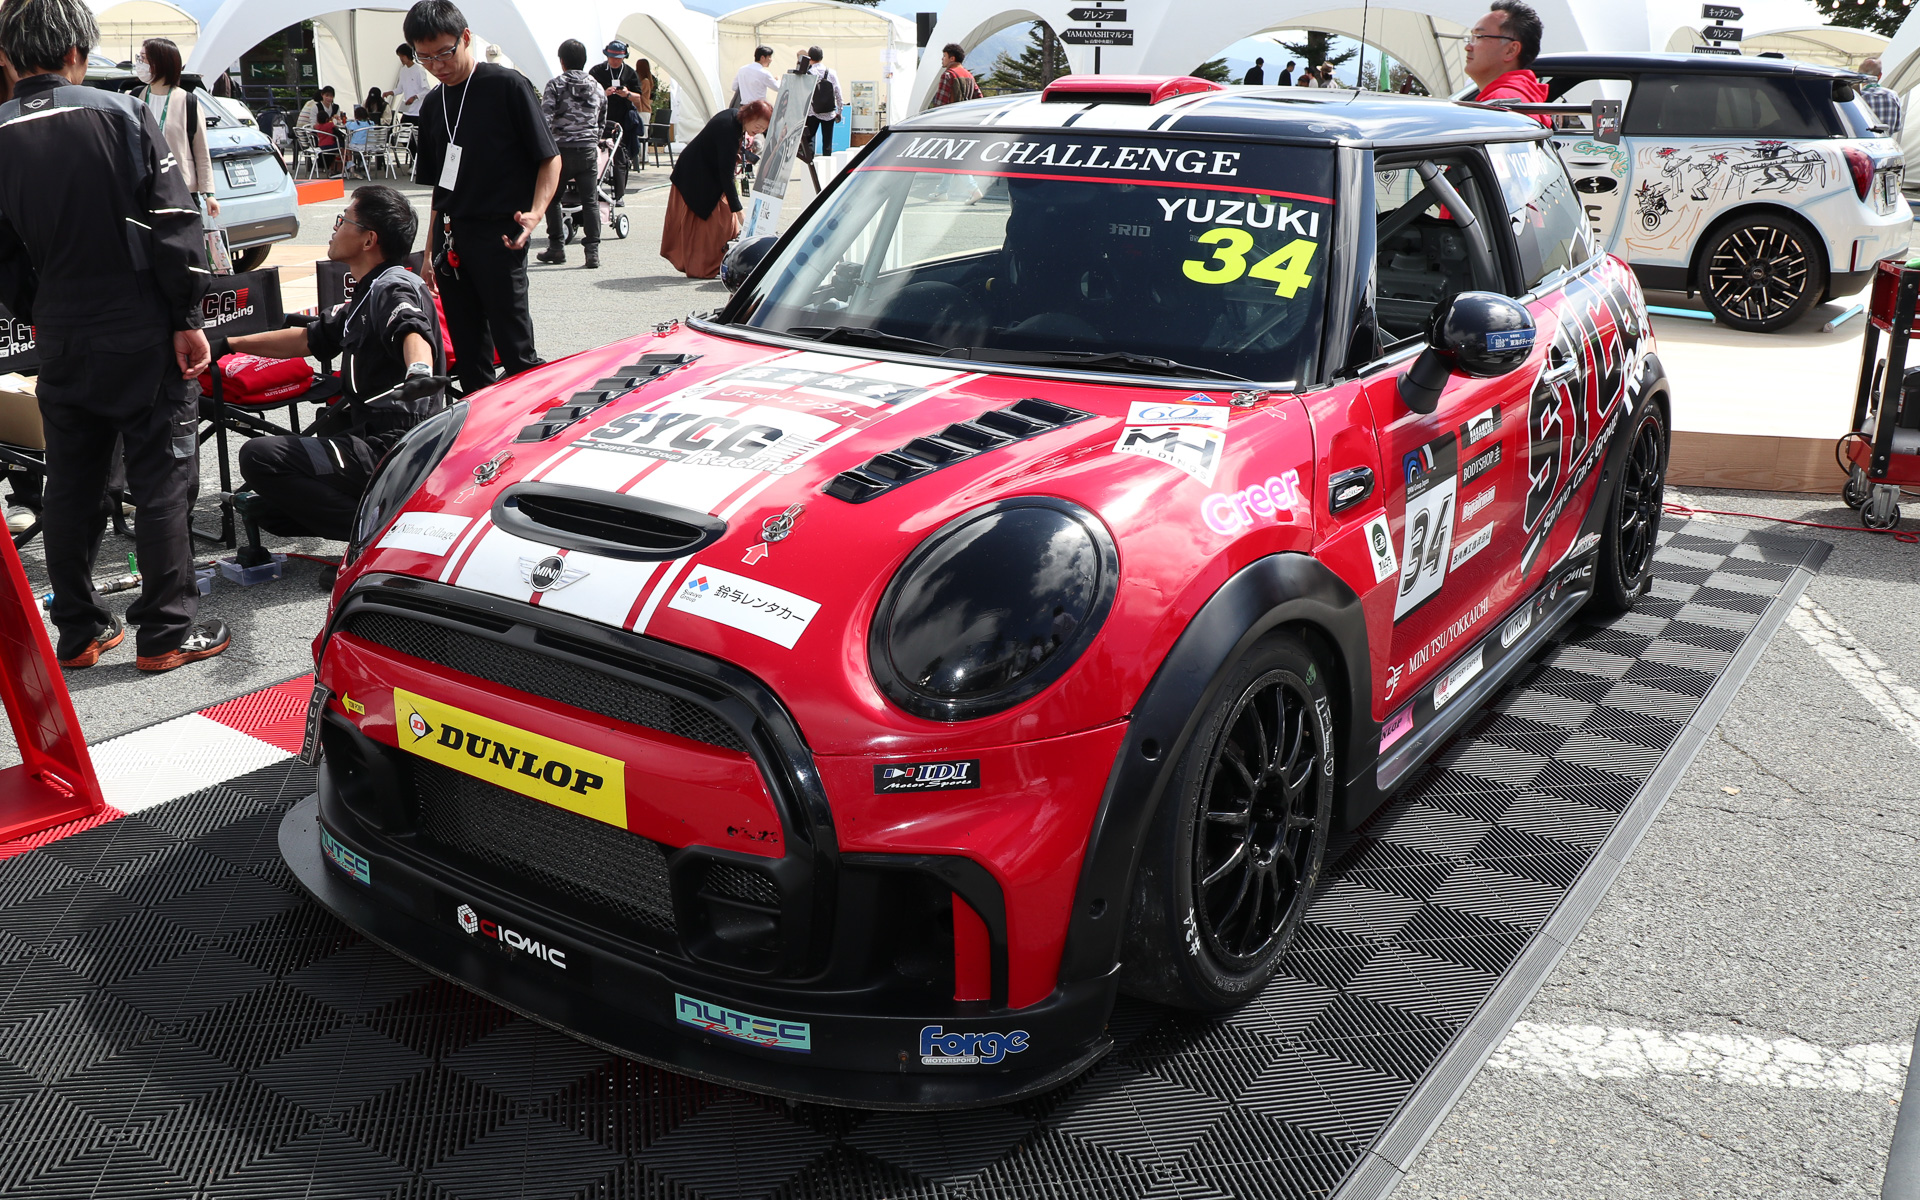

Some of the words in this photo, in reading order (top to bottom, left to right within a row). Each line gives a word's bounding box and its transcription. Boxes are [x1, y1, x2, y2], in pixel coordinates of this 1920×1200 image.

[1083, 11, 1114, 19] ゲレンデ
[1066, 30, 1133, 39] YAMANASHIマルシェ
[897, 136, 981, 162] MINI
[979, 139, 1241, 176] CHALLENGE
[1157, 198, 1319, 238] YUZUKI
[1182, 227, 1318, 299] 34
[218, 304, 254, 326] Racing
[10, 339, 36, 356] Rac
[719, 390, 872, 421] Jネットレンタカー
[590, 411, 783, 457] SYCG
[593, 442, 626, 452] Sanyo
[625, 445, 647, 455] Cars
[648, 449, 681, 460] Group
[686, 449, 806, 475] Racing
[1121, 447, 1208, 480] HOLDINGS
[1463, 451, 1494, 481] BODYSHOP
[1541, 487, 1570, 538] Sanyo
[1571, 455, 1593, 491] Cars
[1593, 411, 1619, 458] Group
[1201, 469, 1300, 536] Creer
[1400, 493, 1453, 597] 34
[534, 564, 560, 580] MINI
[713, 585, 806, 625] 鈴与レンタカー
[1409, 645, 1430, 676] MINI
[1430, 596, 1490, 657] TSU/YOKKAICHI
[304, 691, 320, 749] LUKE
[1380, 717, 1403, 742] NLOP
[437, 723, 604, 796] DUNLOP
[916, 762, 970, 782] IDI
[480, 919, 566, 969] GIOMIC
[679, 998, 807, 1041] NUTEC
[692, 1018, 791, 1047] Racing
[924, 1057, 977, 1065] MOTORSPORT
